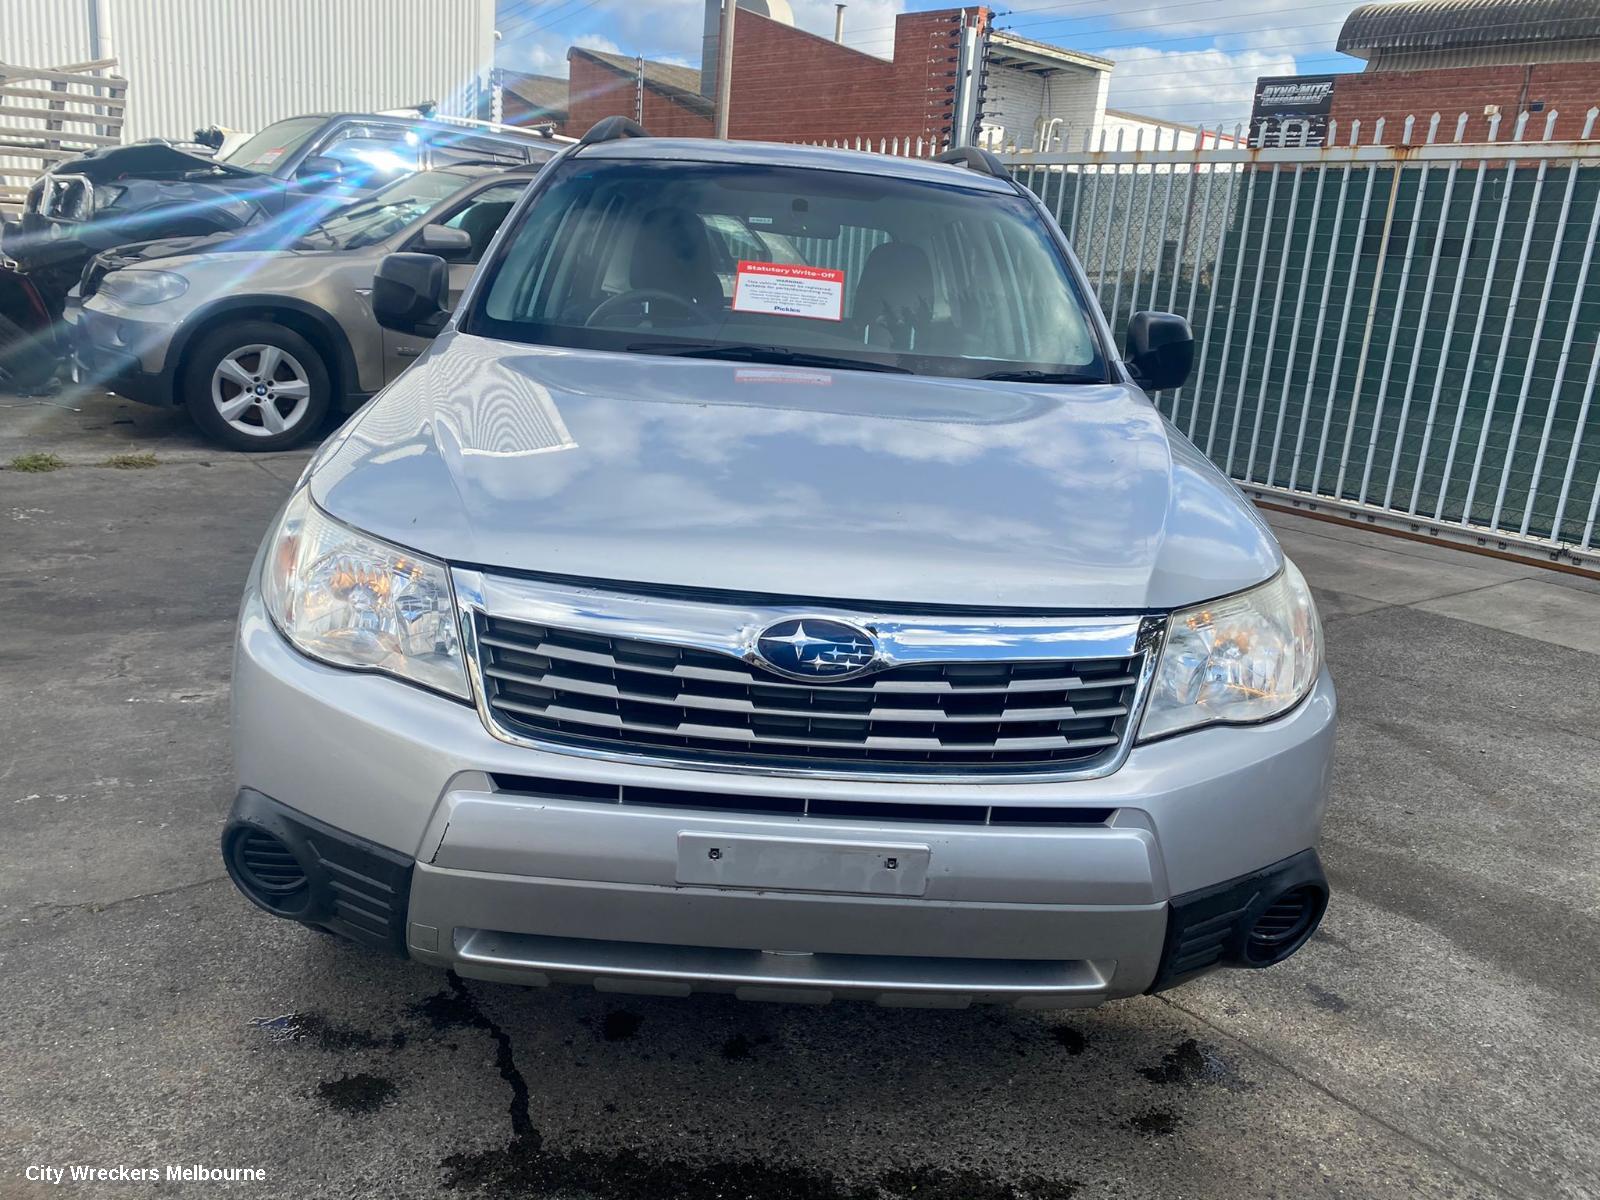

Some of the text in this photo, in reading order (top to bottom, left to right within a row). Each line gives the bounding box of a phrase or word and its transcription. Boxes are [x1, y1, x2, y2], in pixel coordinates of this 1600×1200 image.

[746, 264, 836, 279] Statutory Write-Off
[774, 305, 801, 313] Pickles
